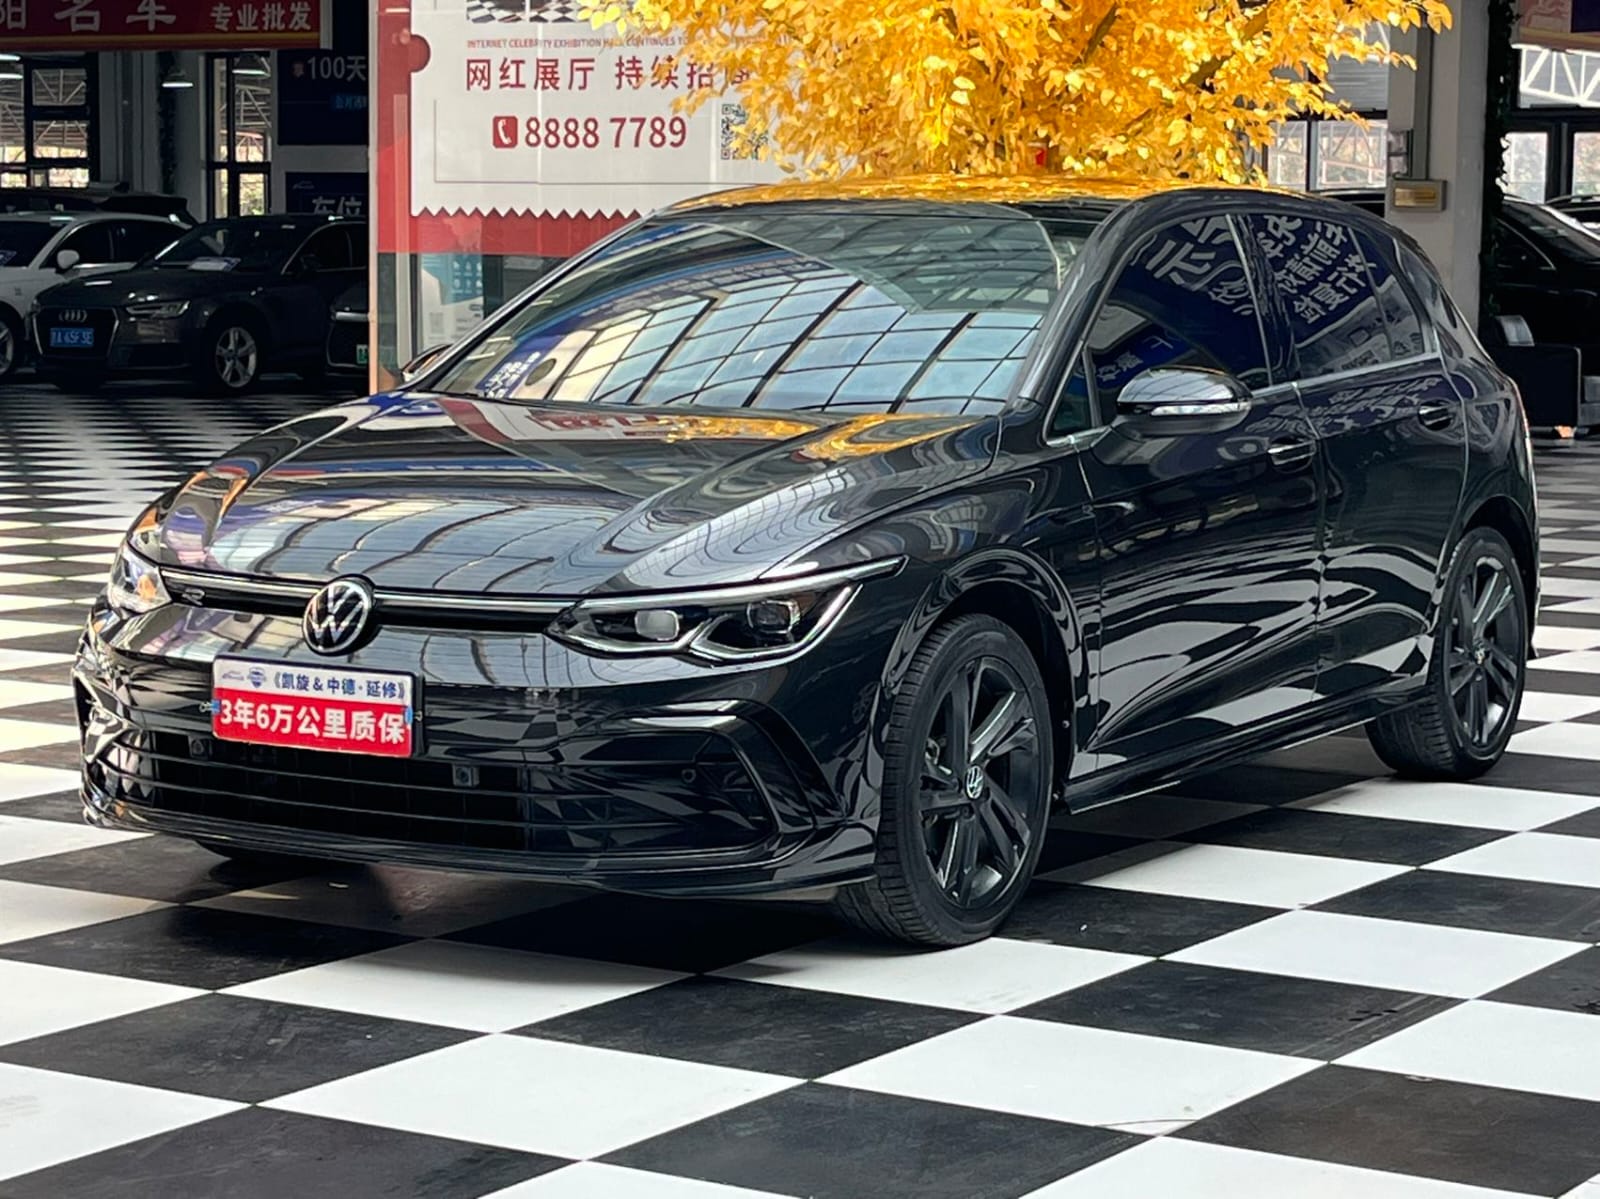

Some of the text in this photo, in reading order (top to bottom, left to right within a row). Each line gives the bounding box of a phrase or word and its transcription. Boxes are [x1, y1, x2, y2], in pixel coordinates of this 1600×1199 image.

[210, 2, 312, 32] 专业批发
[467, 39, 507, 48] INTERNET
[553, 39, 600, 48] EXHIBITION
[466, 54, 749, 91] 网红展厅 持续招
[525, 116, 687, 149] 8888 7789
[219, 697, 406, 745] 3年6万公里质保
